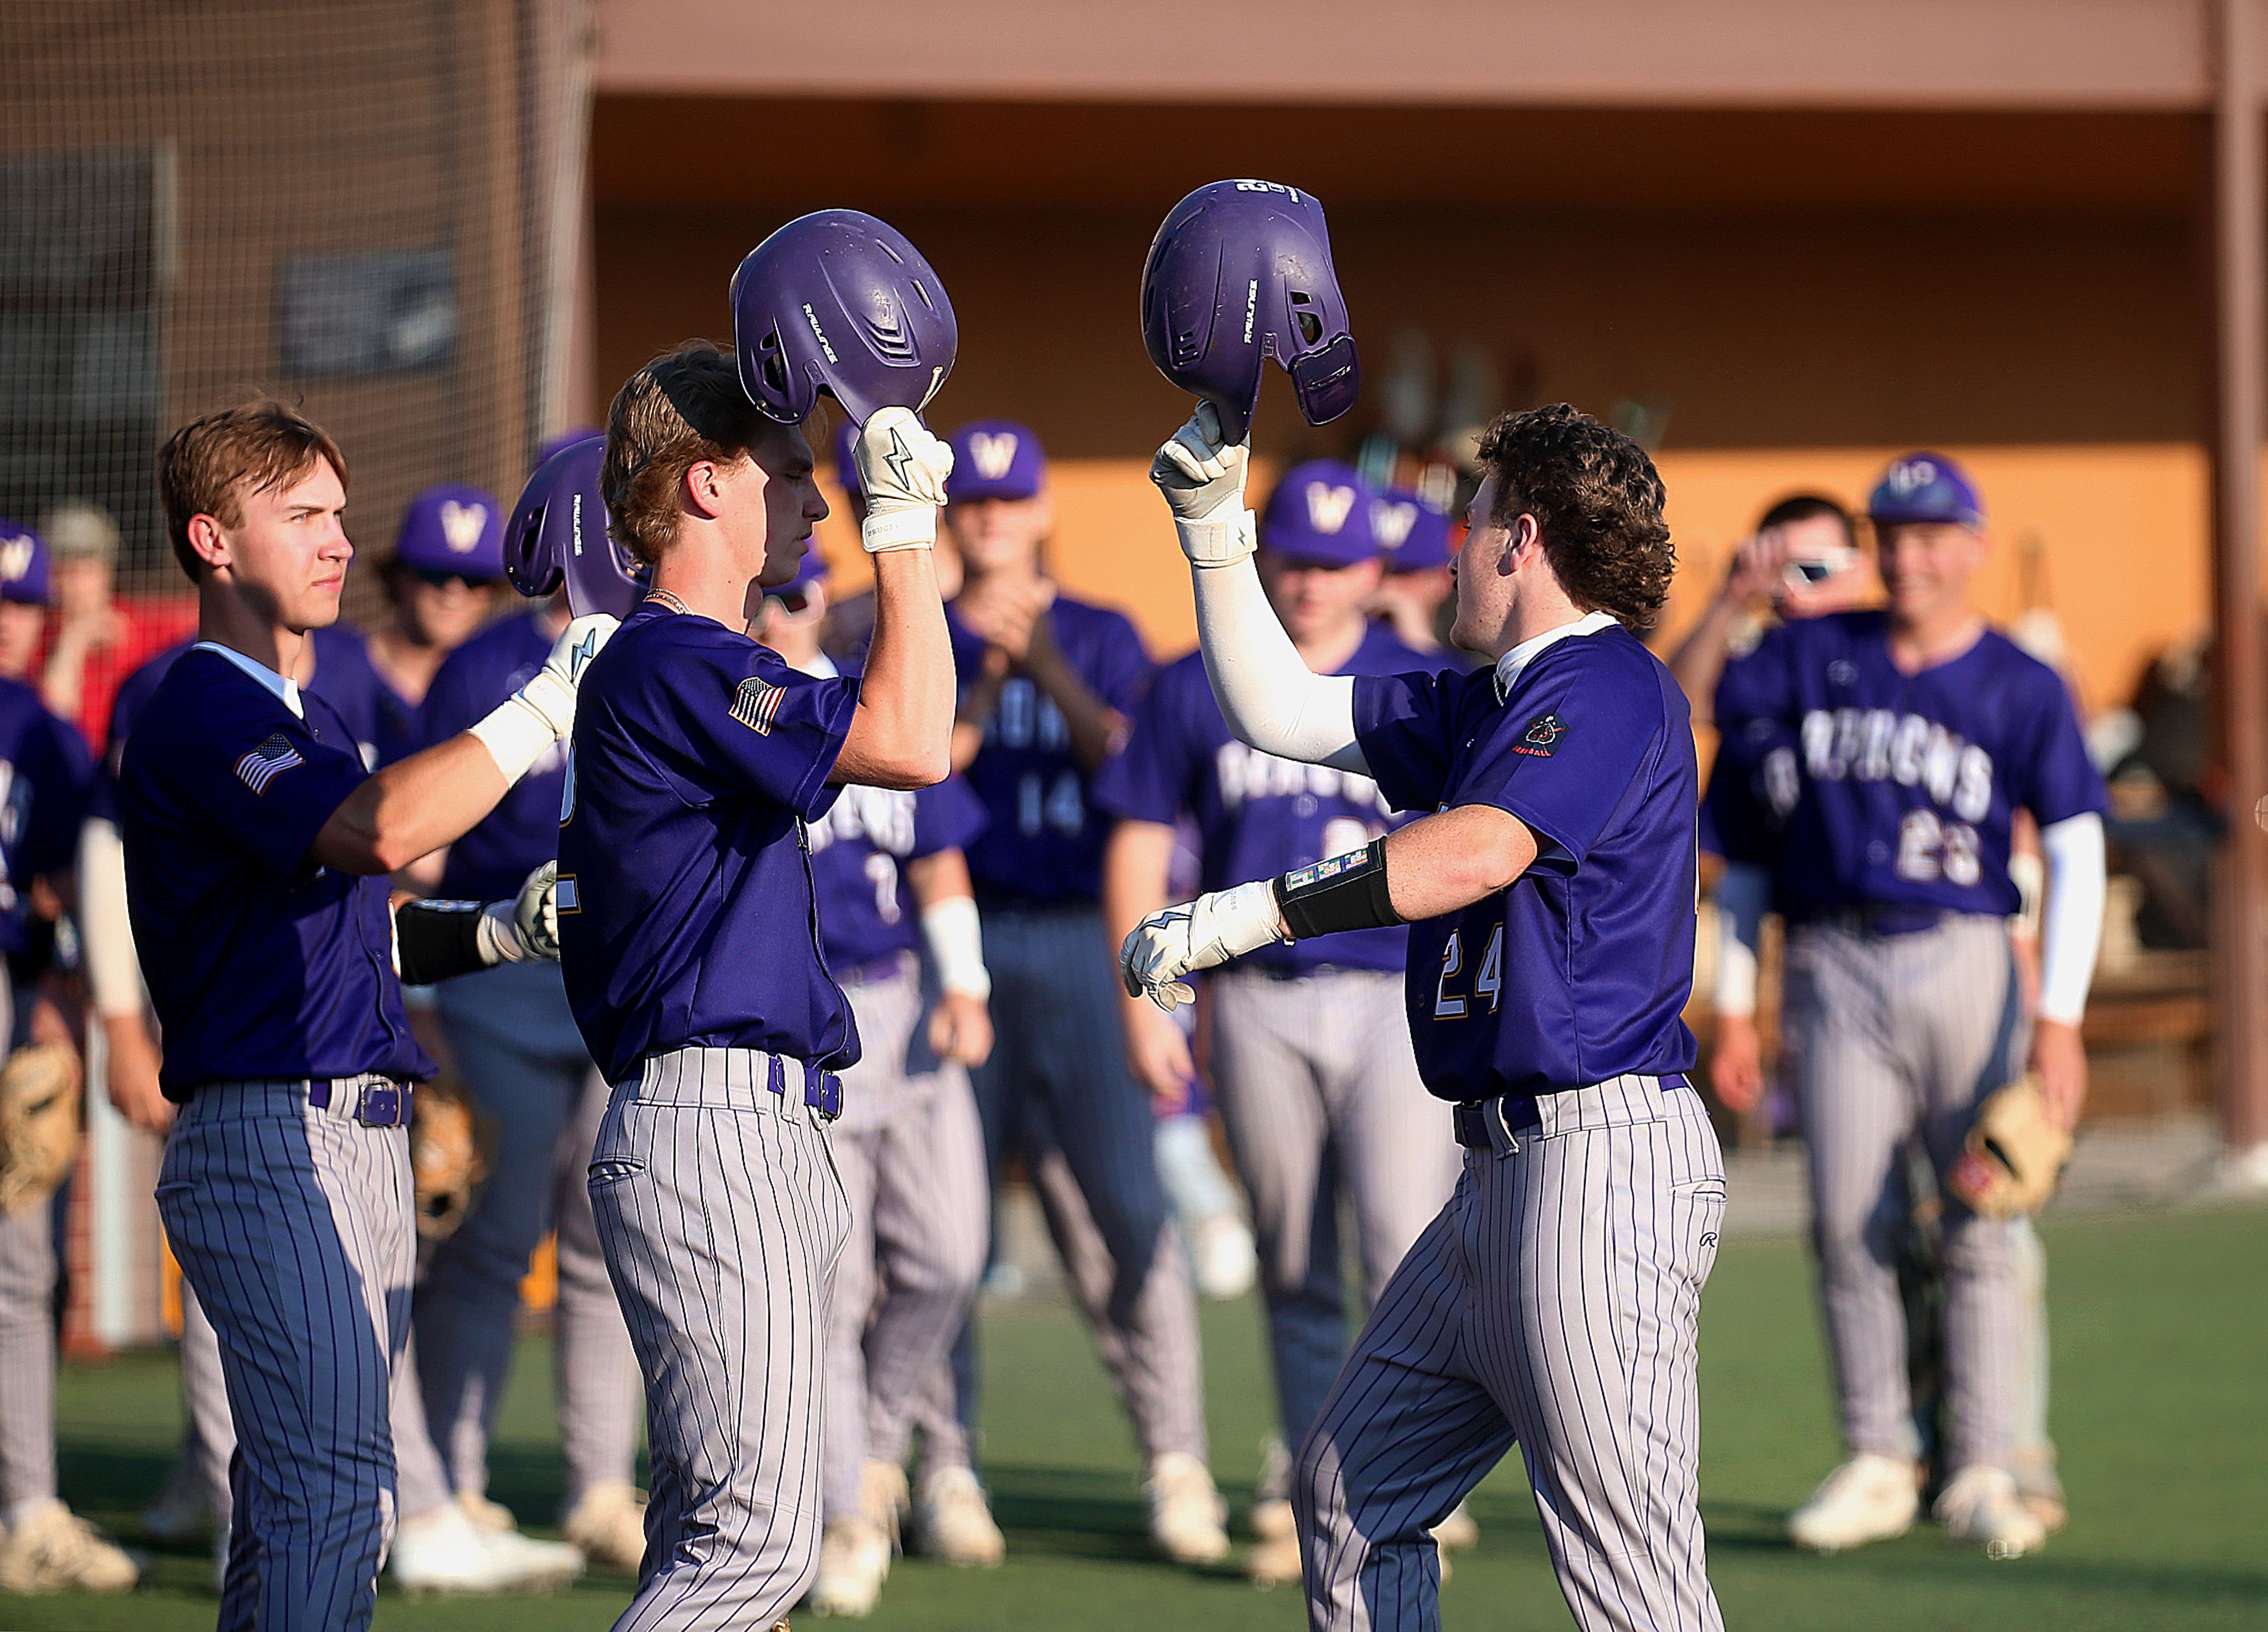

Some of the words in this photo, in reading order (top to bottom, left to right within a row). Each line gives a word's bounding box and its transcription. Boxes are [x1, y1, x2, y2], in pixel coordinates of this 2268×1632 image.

[802, 303, 839, 365] RAWLINGS
[1244, 279, 1258, 343] RAWLINGS
[969, 431, 1018, 481] W
[441, 499, 488, 554] W
[573, 493, 583, 556] RAWLINGS
[1306, 481, 1356, 535] W
[1369, 498, 1418, 550] W
[1019, 770, 1086, 838] 14
[1433, 922, 1504, 1021] 24
